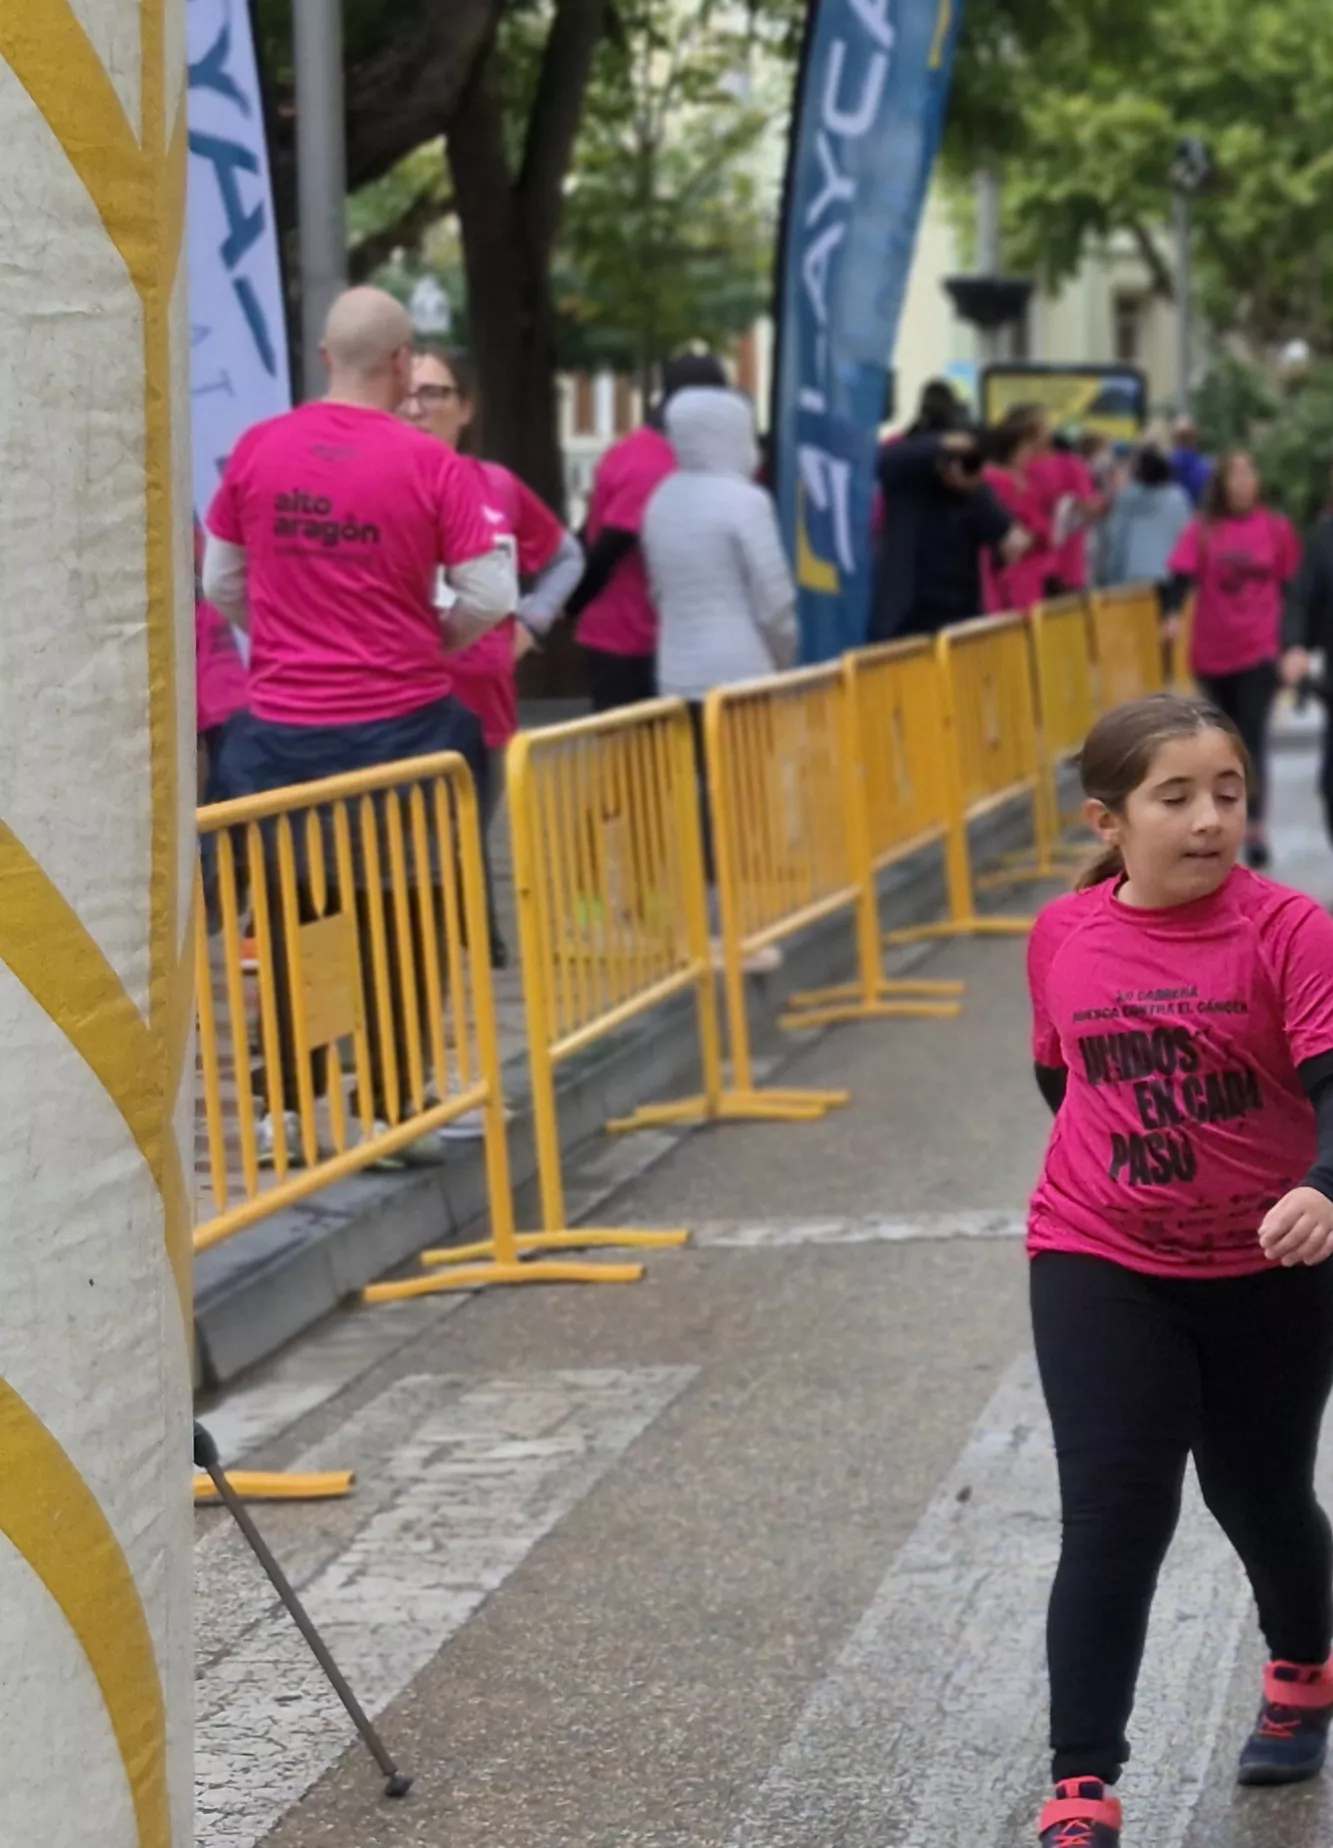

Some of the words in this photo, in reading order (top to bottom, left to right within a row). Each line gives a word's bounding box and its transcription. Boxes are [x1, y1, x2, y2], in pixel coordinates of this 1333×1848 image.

[274, 488, 332, 516] alto
[1072, 1006, 1120, 1023] HUESCA
[1121, 1003, 1175, 1019] CONTRA
[1177, 1001, 1193, 1015] EL
[1136, 985, 1198, 1002] CARRERA
[1077, 1026, 1199, 1086] UNIDOS
[1132, 1078, 1183, 1130] EN
[1181, 1068, 1264, 1123] CADA
[1108, 1130, 1198, 1187] PASO
